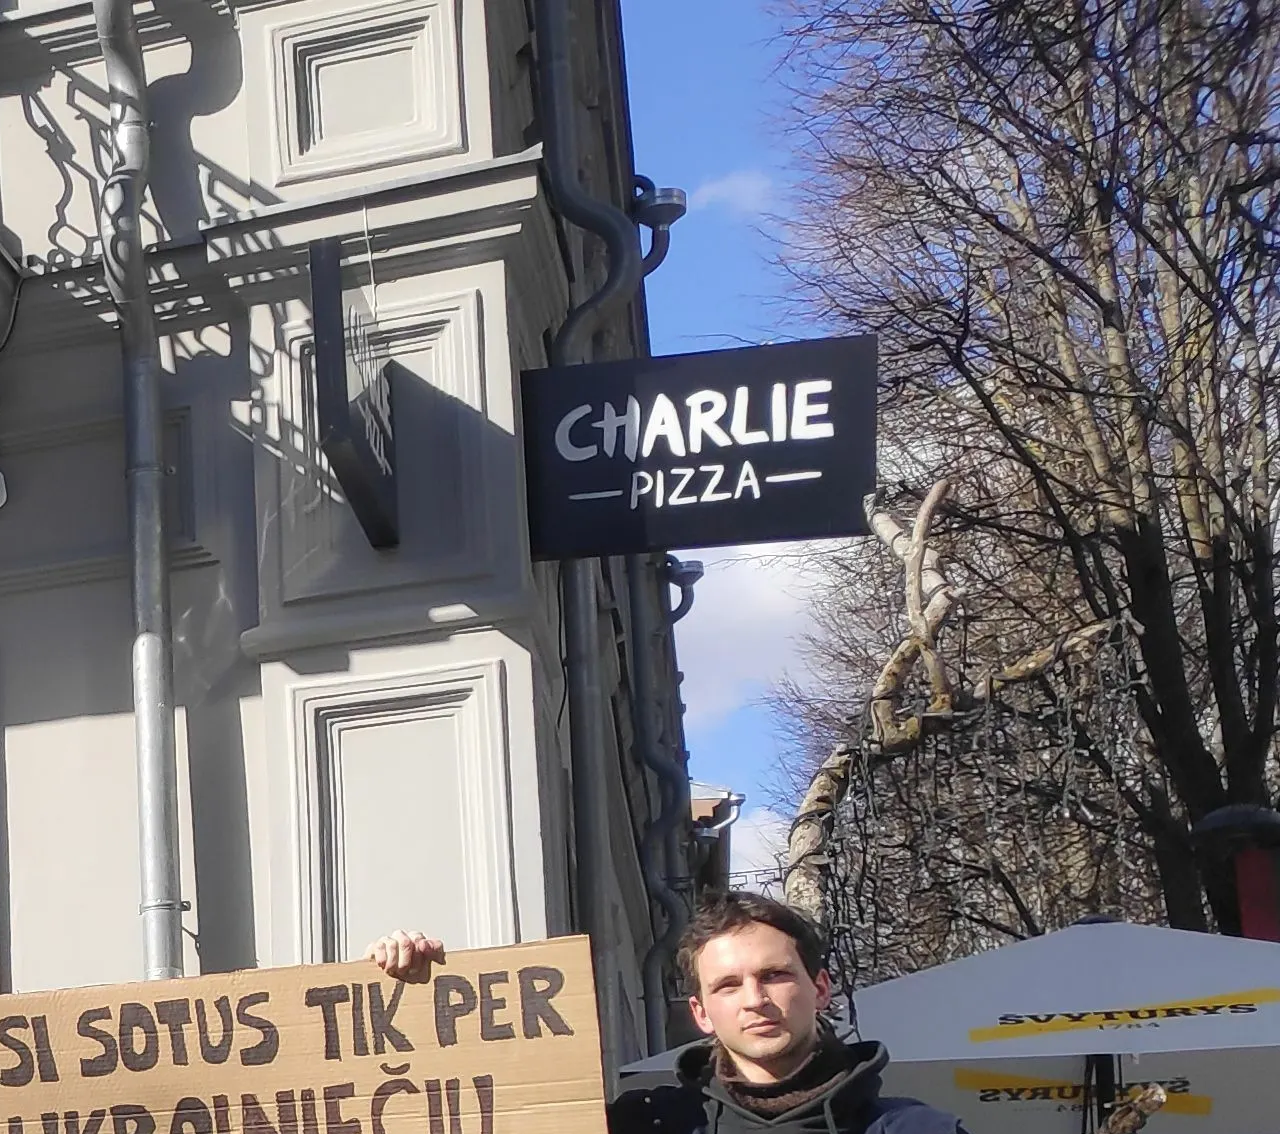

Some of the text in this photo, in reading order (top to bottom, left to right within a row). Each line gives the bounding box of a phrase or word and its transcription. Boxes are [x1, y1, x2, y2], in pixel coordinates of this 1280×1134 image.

[554, 379, 835, 463] CHARLIE
[630, 460, 761, 510] PIZZA
[78, 991, 280, 1078] SOTUS
[305, 979, 416, 1062] TIK
[433, 965, 575, 1048] PER
